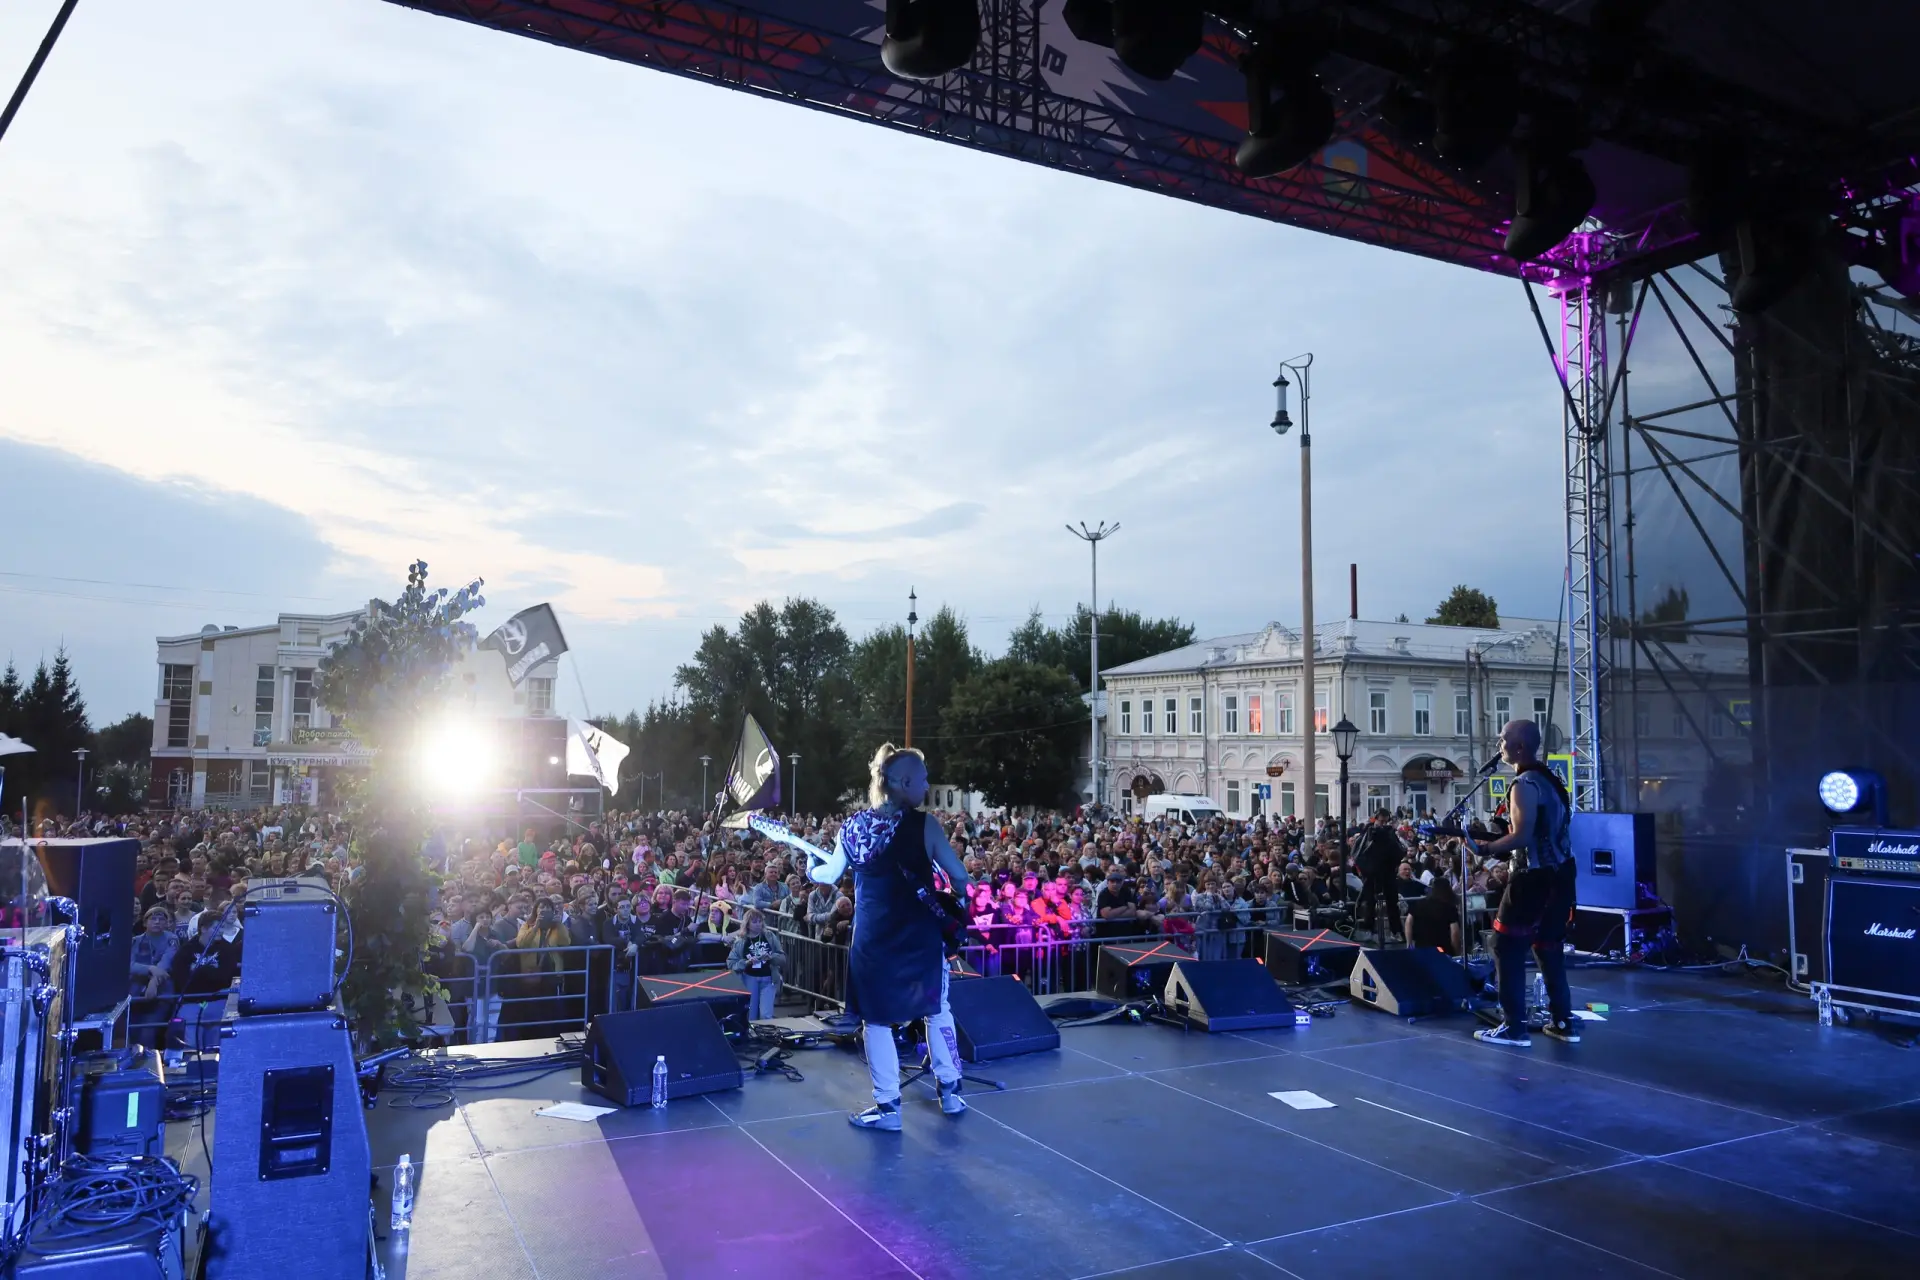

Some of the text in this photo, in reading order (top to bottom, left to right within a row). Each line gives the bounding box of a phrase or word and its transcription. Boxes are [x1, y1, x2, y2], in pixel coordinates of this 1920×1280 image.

[270, 756, 338, 766] КУЛЬТУРНЫЙ
[1867, 840, 1919, 855] Marshall
[1863, 922, 1916, 939] Marshall
